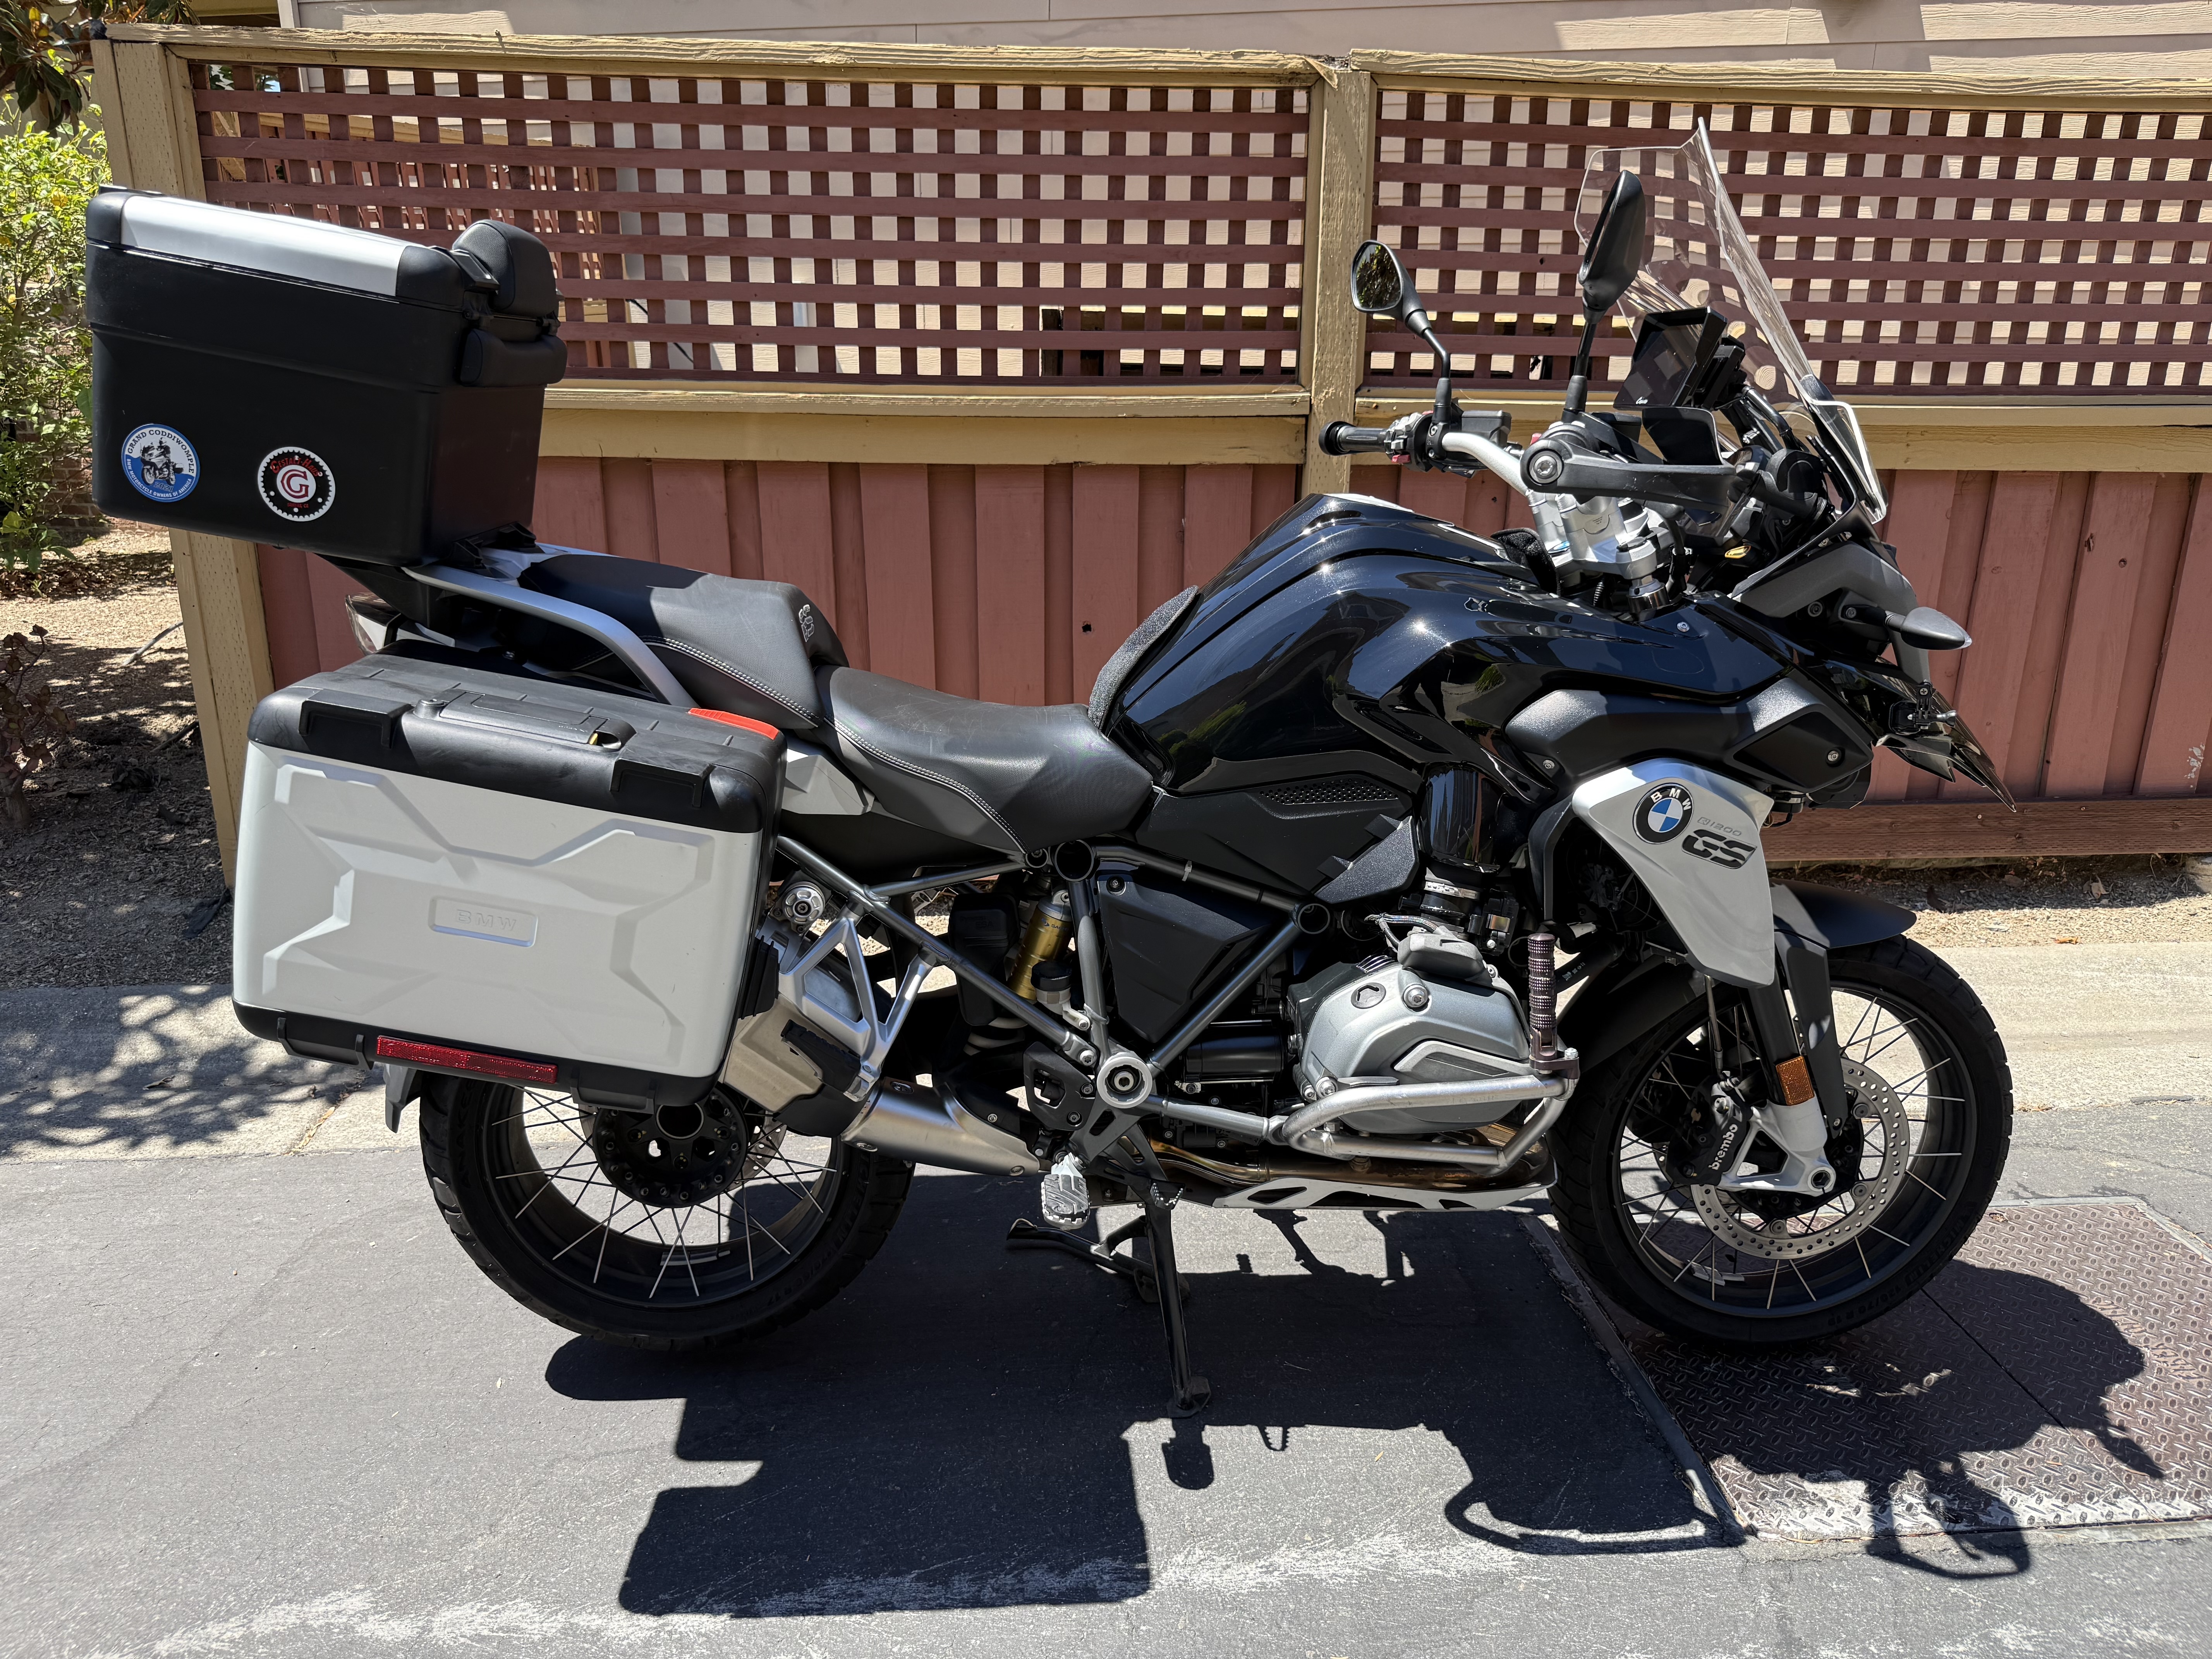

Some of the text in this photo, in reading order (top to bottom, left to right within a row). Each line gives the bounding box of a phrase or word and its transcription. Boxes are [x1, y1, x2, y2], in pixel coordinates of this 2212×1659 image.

[127, 430, 194, 473] GRAND CODDIWOMPLE
[129, 471, 153, 494] MOTORCYCLE
[179, 478, 192, 494] AMERICA
[154, 482, 174, 492] 2021
[281, 469, 309, 499] G
[1650, 788, 1691, 811] BMW
[1681, 829, 1757, 869] GS
[456, 909, 517, 931] BMW
[1708, 1124, 1738, 1170] brembo
